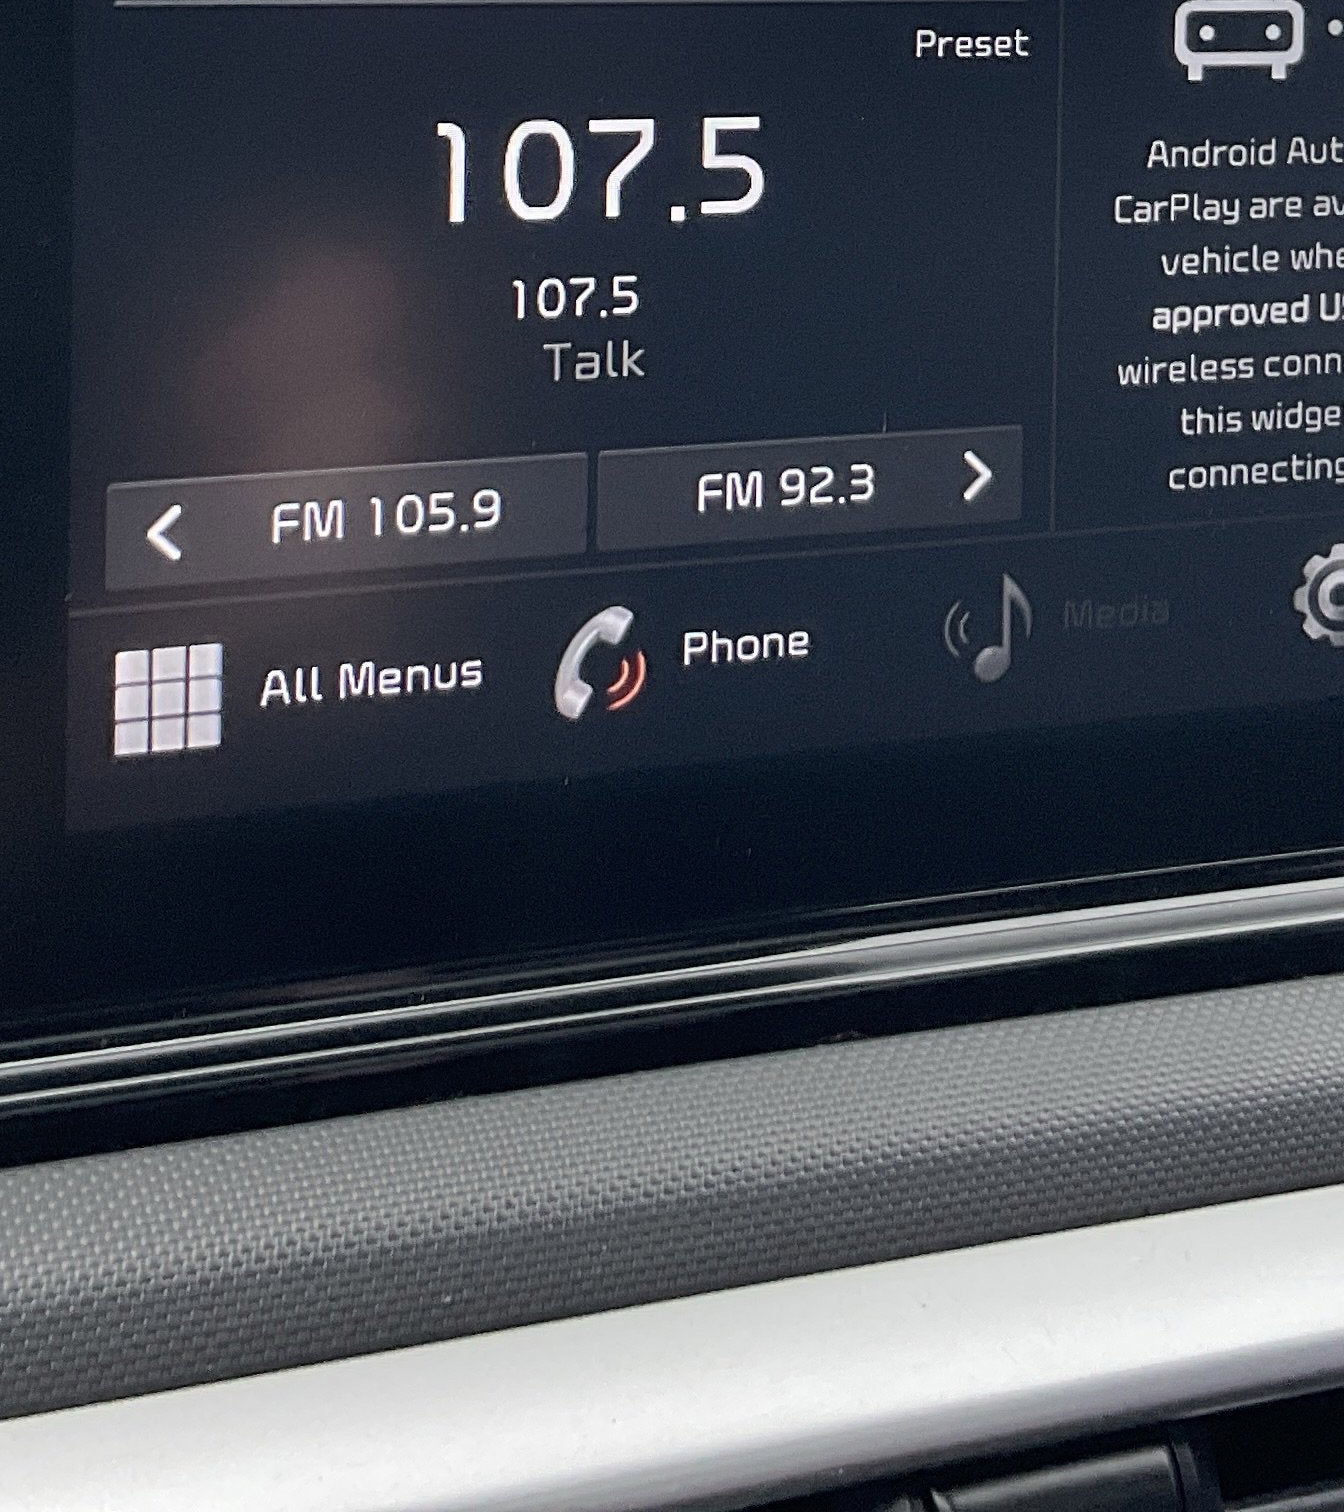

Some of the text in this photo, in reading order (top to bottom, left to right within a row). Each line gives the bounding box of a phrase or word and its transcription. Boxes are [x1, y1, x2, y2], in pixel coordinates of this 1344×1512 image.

[915, 28, 1029, 58] Preset
[437, 116, 765, 223] 107.5
[1147, 137, 1277, 169] Android
[1114, 193, 1240, 225] CarPlay
[1249, 196, 1303, 219] are
[1161, 244, 1280, 276] vehicle
[512, 275, 639, 319] 107.5
[1152, 293, 1310, 335] approved
[542, 339, 645, 382] Talk
[1117, 353, 1254, 386] wireless
[1180, 406, 1243, 436] this
[697, 463, 875, 514] FM 92.3
[271, 489, 501, 544] FM 105.9
[1062, 594, 1169, 629] Media
[683, 629, 809, 666] Phone
[259, 659, 482, 707] All Menus
